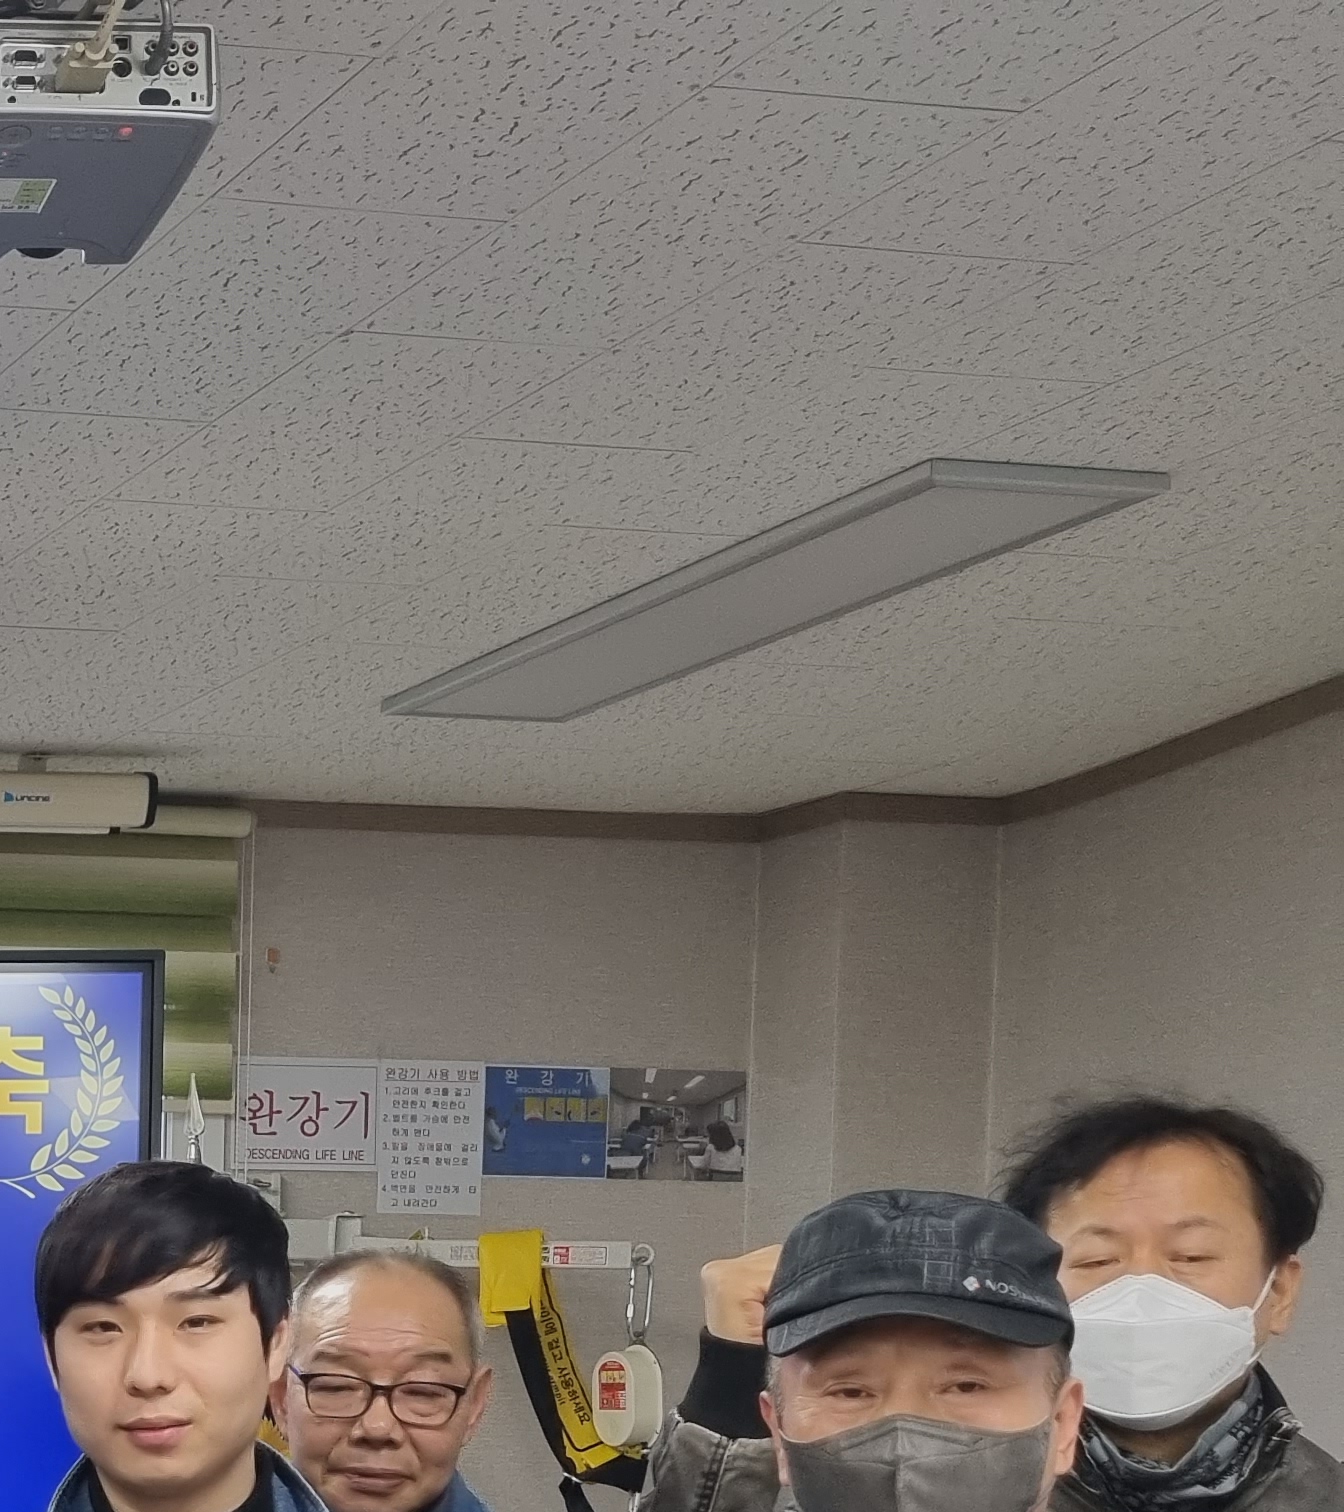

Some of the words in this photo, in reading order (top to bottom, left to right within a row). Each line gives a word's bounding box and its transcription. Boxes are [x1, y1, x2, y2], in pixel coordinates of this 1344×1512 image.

[385, 1067, 420, 1080] 완강기
[427, 1068, 450, 1080] 사용
[457, 1069, 479, 1081] 방법
[239, 1089, 370, 1140] 완강기
[315, 1149, 337, 1160] LIFE
[342, 1150, 365, 1161] LINE
[547, 1338, 563, 1363] 걸고
[557, 1367, 591, 1426] 사용하세요
